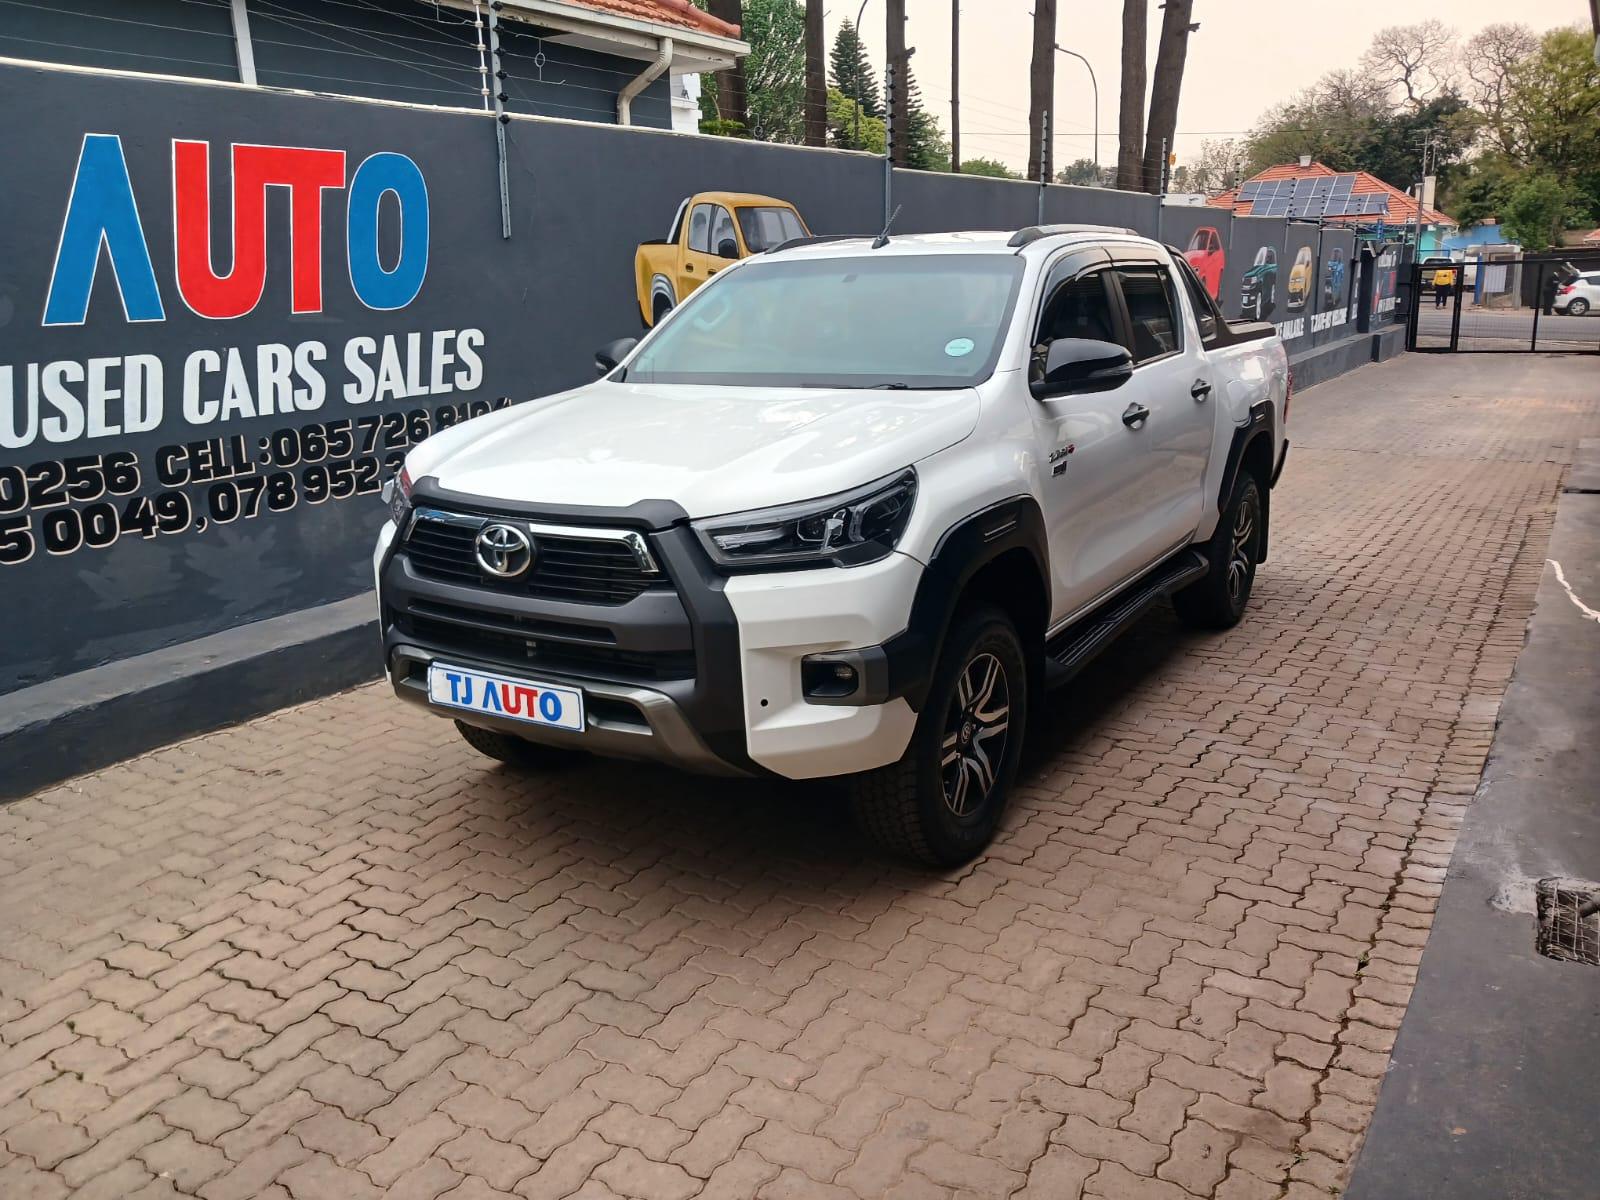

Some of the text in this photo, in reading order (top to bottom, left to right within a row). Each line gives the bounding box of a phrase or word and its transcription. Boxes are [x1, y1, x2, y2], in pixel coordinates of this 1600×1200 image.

[42, 132, 429, 325] AUTO
[0, 328, 486, 449] USED CARS SALES
[302, 456, 382, 504] 952
[446, 673, 563, 722] TJ AUTO
